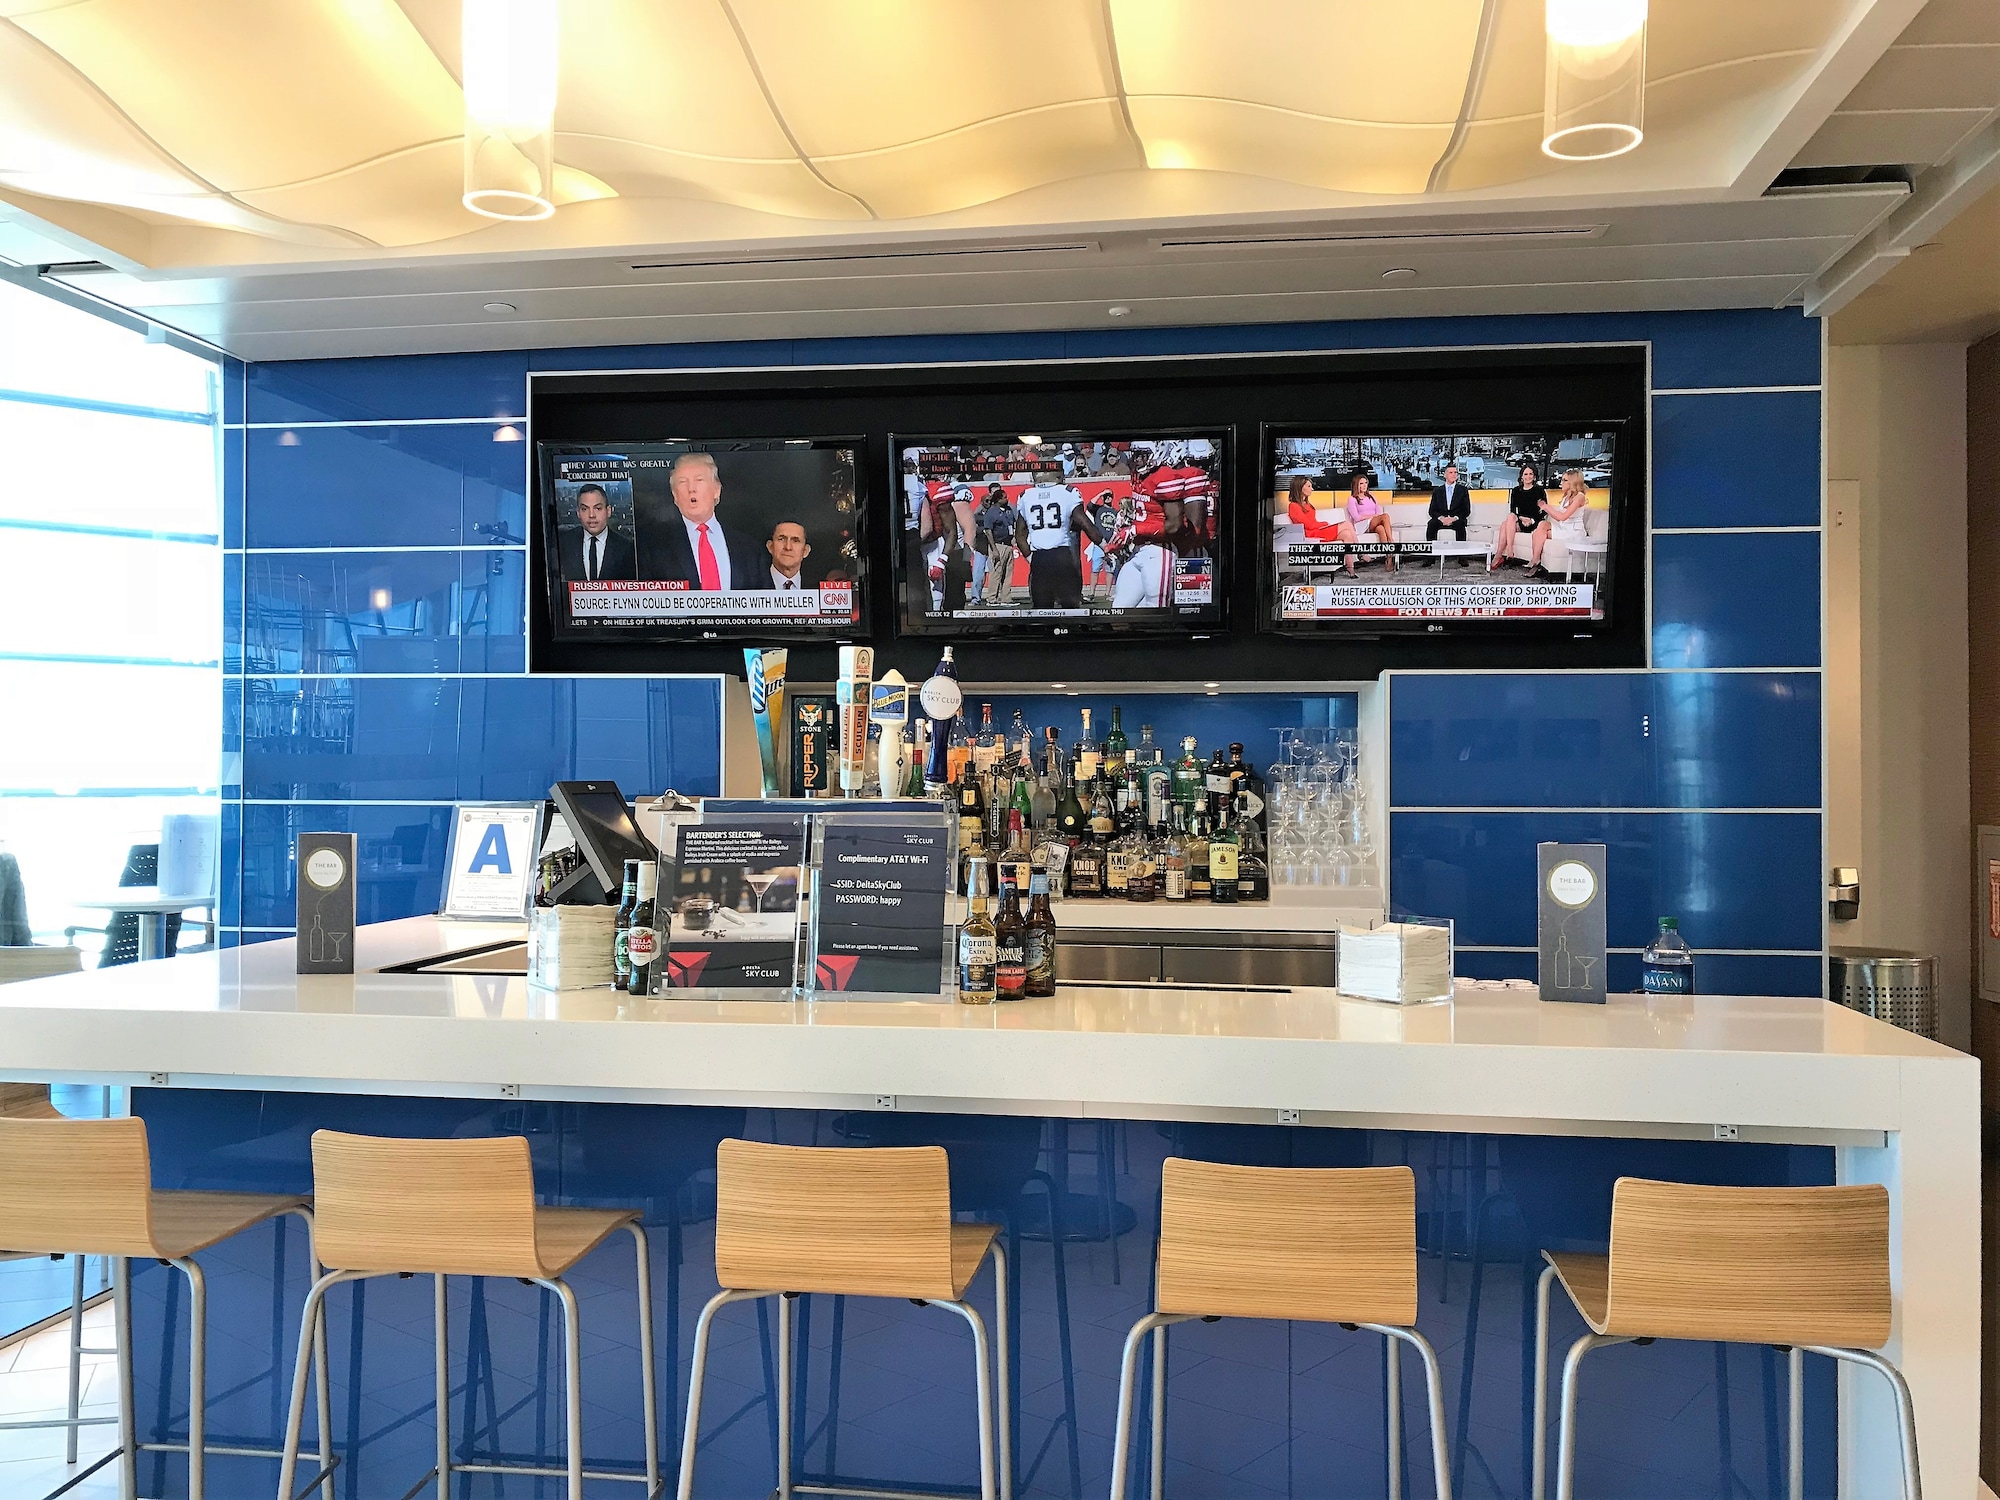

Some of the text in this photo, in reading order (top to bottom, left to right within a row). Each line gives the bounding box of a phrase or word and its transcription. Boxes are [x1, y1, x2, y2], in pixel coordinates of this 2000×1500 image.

[640, 460, 671, 468] GREATLY
[995, 463, 1005, 471] BE
[1044, 462, 1059, 470] THE
[567, 472, 608, 480] CONCERNED
[1030, 502, 1062, 531] 33
[1289, 543, 1433, 553] THEY WERE TALKING ABOUT
[1289, 556, 1343, 564] SANCTION.
[573, 581, 684, 590] RUSSIA INVESTIGATION
[1332, 586, 1577, 596] WHETHER MUELLER GETTING CLOSER TO SHOWING
[574, 596, 814, 609] SOURCE: FLYNN COULD BE COOPERATING WITH MUELLER
[823, 593, 848, 605] CNN
[1294, 594, 1314, 602] FOX
[1331, 597, 1577, 606] RUSSIA COLLUSION OR THIS MORE DRIP, DRIP, DRIP
[1288, 603, 1314, 611] NEWS
[1398, 608, 1506, 616] FOX NEWS ALERT
[656, 618, 696, 626] TREASURY'S
[873, 692, 904, 708] BLUE MOON
[855, 710, 864, 754] SCULPIN
[804, 733, 818, 787] RIPPER
[686, 831, 727, 839] BARTENDER'S
[468, 824, 512, 874] A
[838, 854, 929, 865] Complimentary AT&T Wi-Fi
[1073, 860, 1096, 871] KNOB
[837, 880, 902, 891] SSID: DeltaSkyClub
[836, 894, 901, 906] PASSWORD: happy
[962, 938, 992, 949] Corona
[997, 946, 1024, 955] SAMUEL
[998, 954, 1023, 962] ADAMS
[1644, 974, 1683, 989] DASANI
